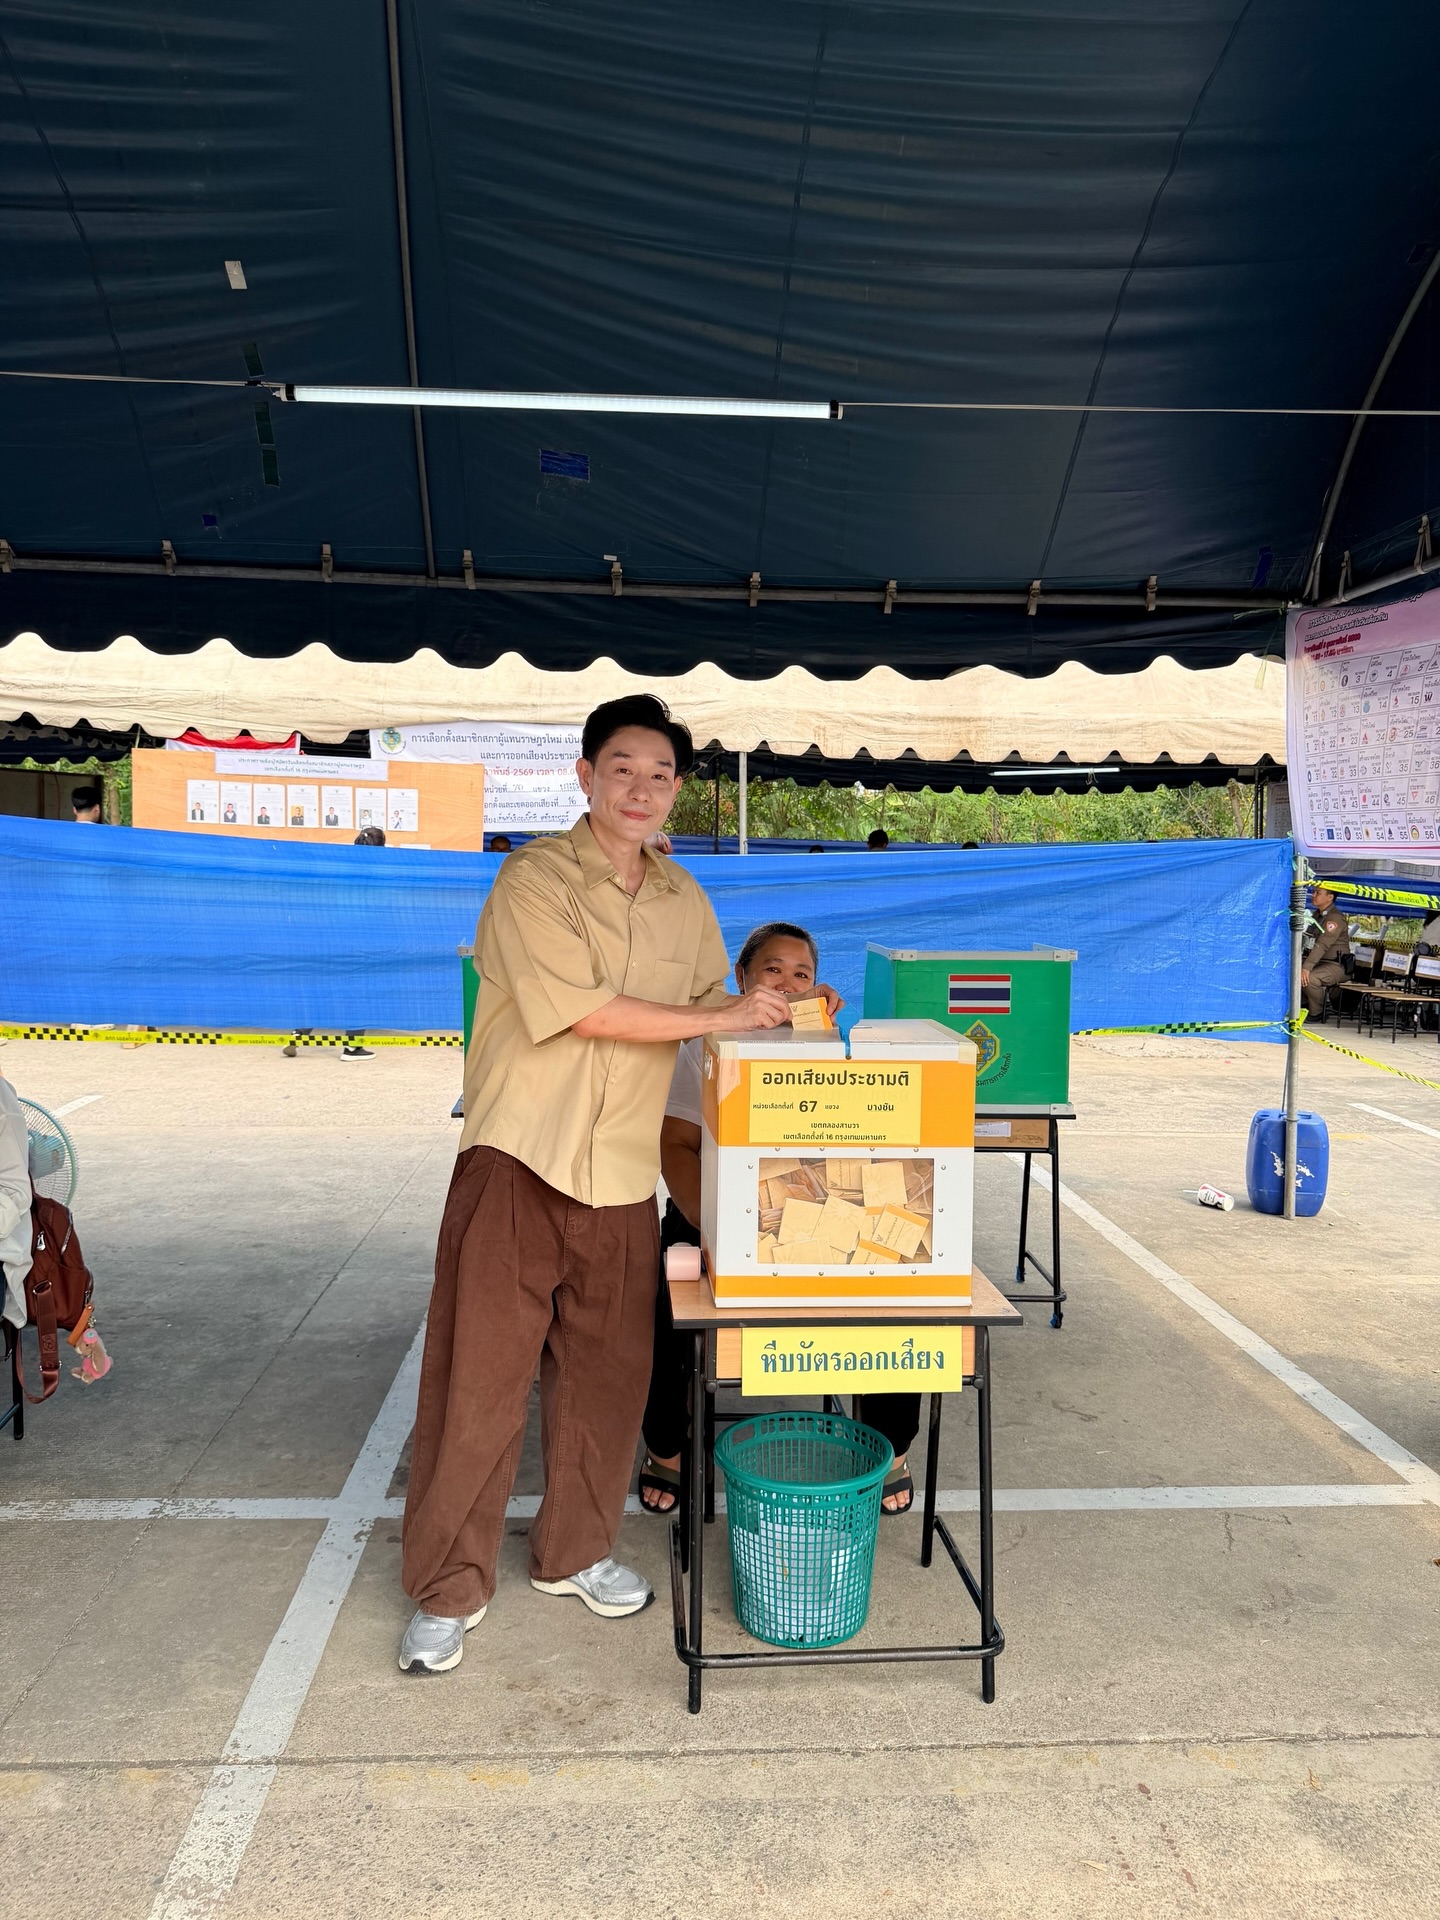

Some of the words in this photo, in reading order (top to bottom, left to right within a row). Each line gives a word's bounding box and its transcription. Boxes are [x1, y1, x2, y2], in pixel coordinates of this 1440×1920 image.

[411, 730, 562, 747] การเลือกตั้งสมาชิกสภาผู้แทนราษฎรใหม่
[564, 732, 581, 745] เป็น
[513, 768, 534, 776] 2569
[536, 768, 555, 776] เวลา
[557, 767, 576, 776] 08.0
[483, 797, 559, 809] อกตั้งและเขตออกเสียงที่
[762, 1068, 910, 1087] ออกเสียงประชามติ
[752, 1101, 794, 1110] หน่วยเลือกตั้งที่
[799, 1100, 818, 1113] 67
[867, 1102, 894, 1112] บางชัน
[783, 1131, 825, 1141] เขตเลือกตั้งที่
[826, 1133, 834, 1141] 16
[834, 1134, 887, 1142] กรุงเทพมหานคร
[760, 1337, 945, 1373] หีบบัตรออกเสียง
